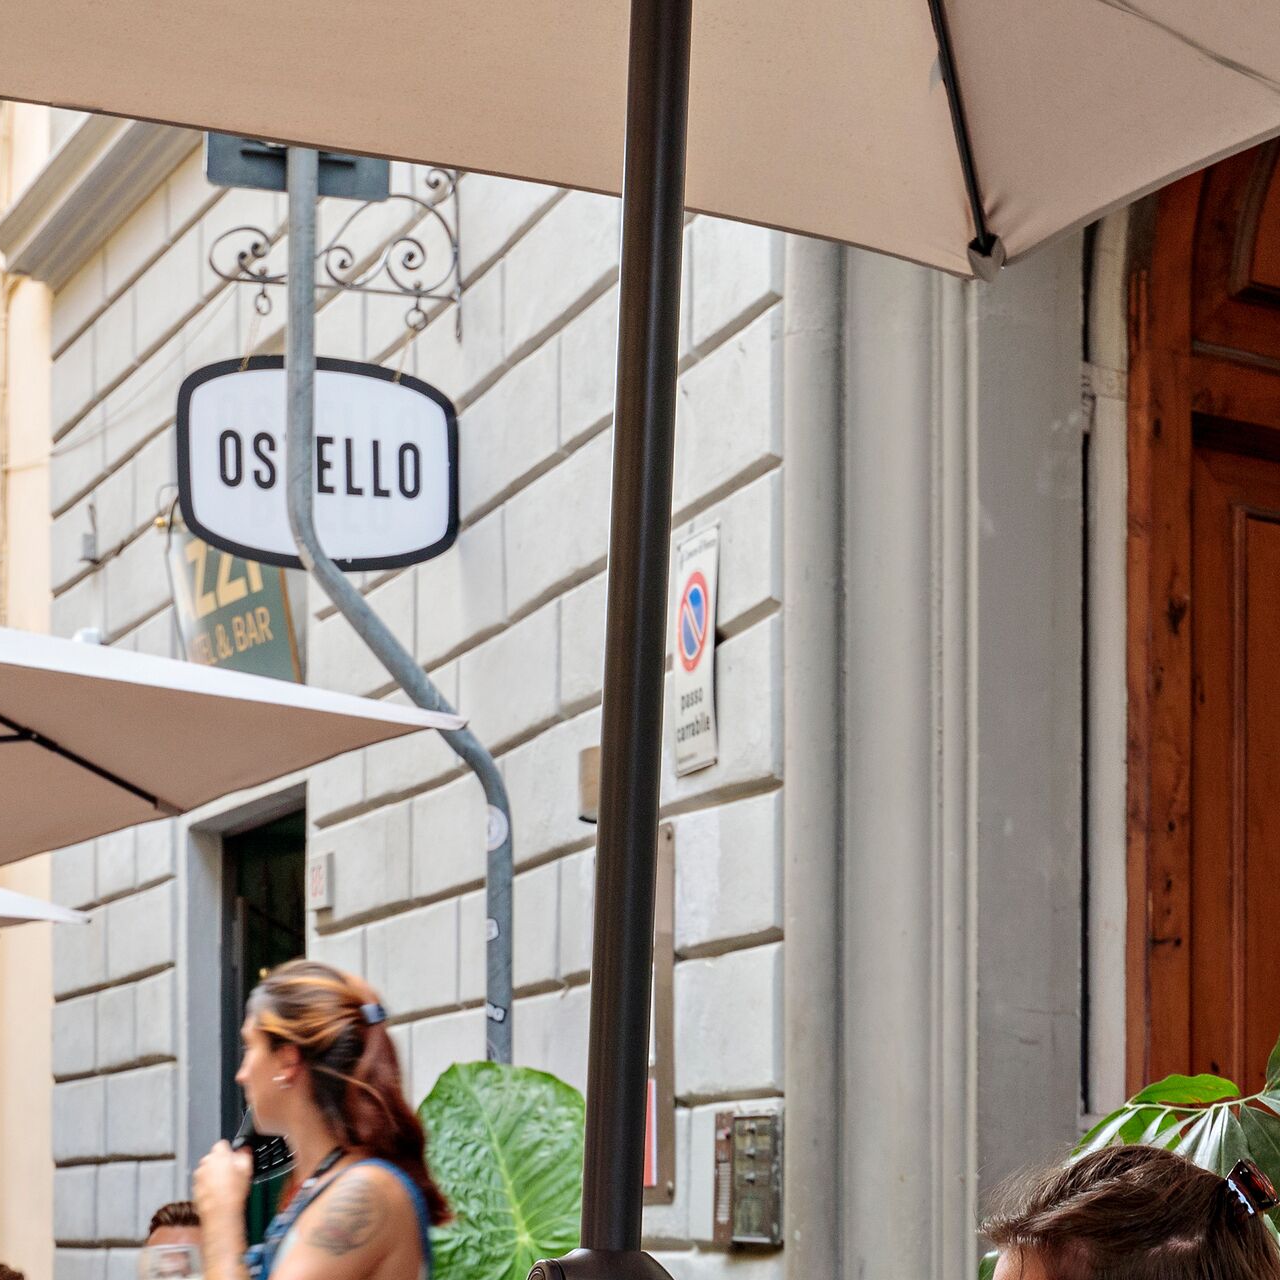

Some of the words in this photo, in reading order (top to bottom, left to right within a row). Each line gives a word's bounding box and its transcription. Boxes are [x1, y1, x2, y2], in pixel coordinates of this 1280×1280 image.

[219, 429, 421, 499] OSELLO
[231, 606, 273, 652] BAR
[680, 687, 704, 715] passo
[676, 713, 711, 743] carrabile
